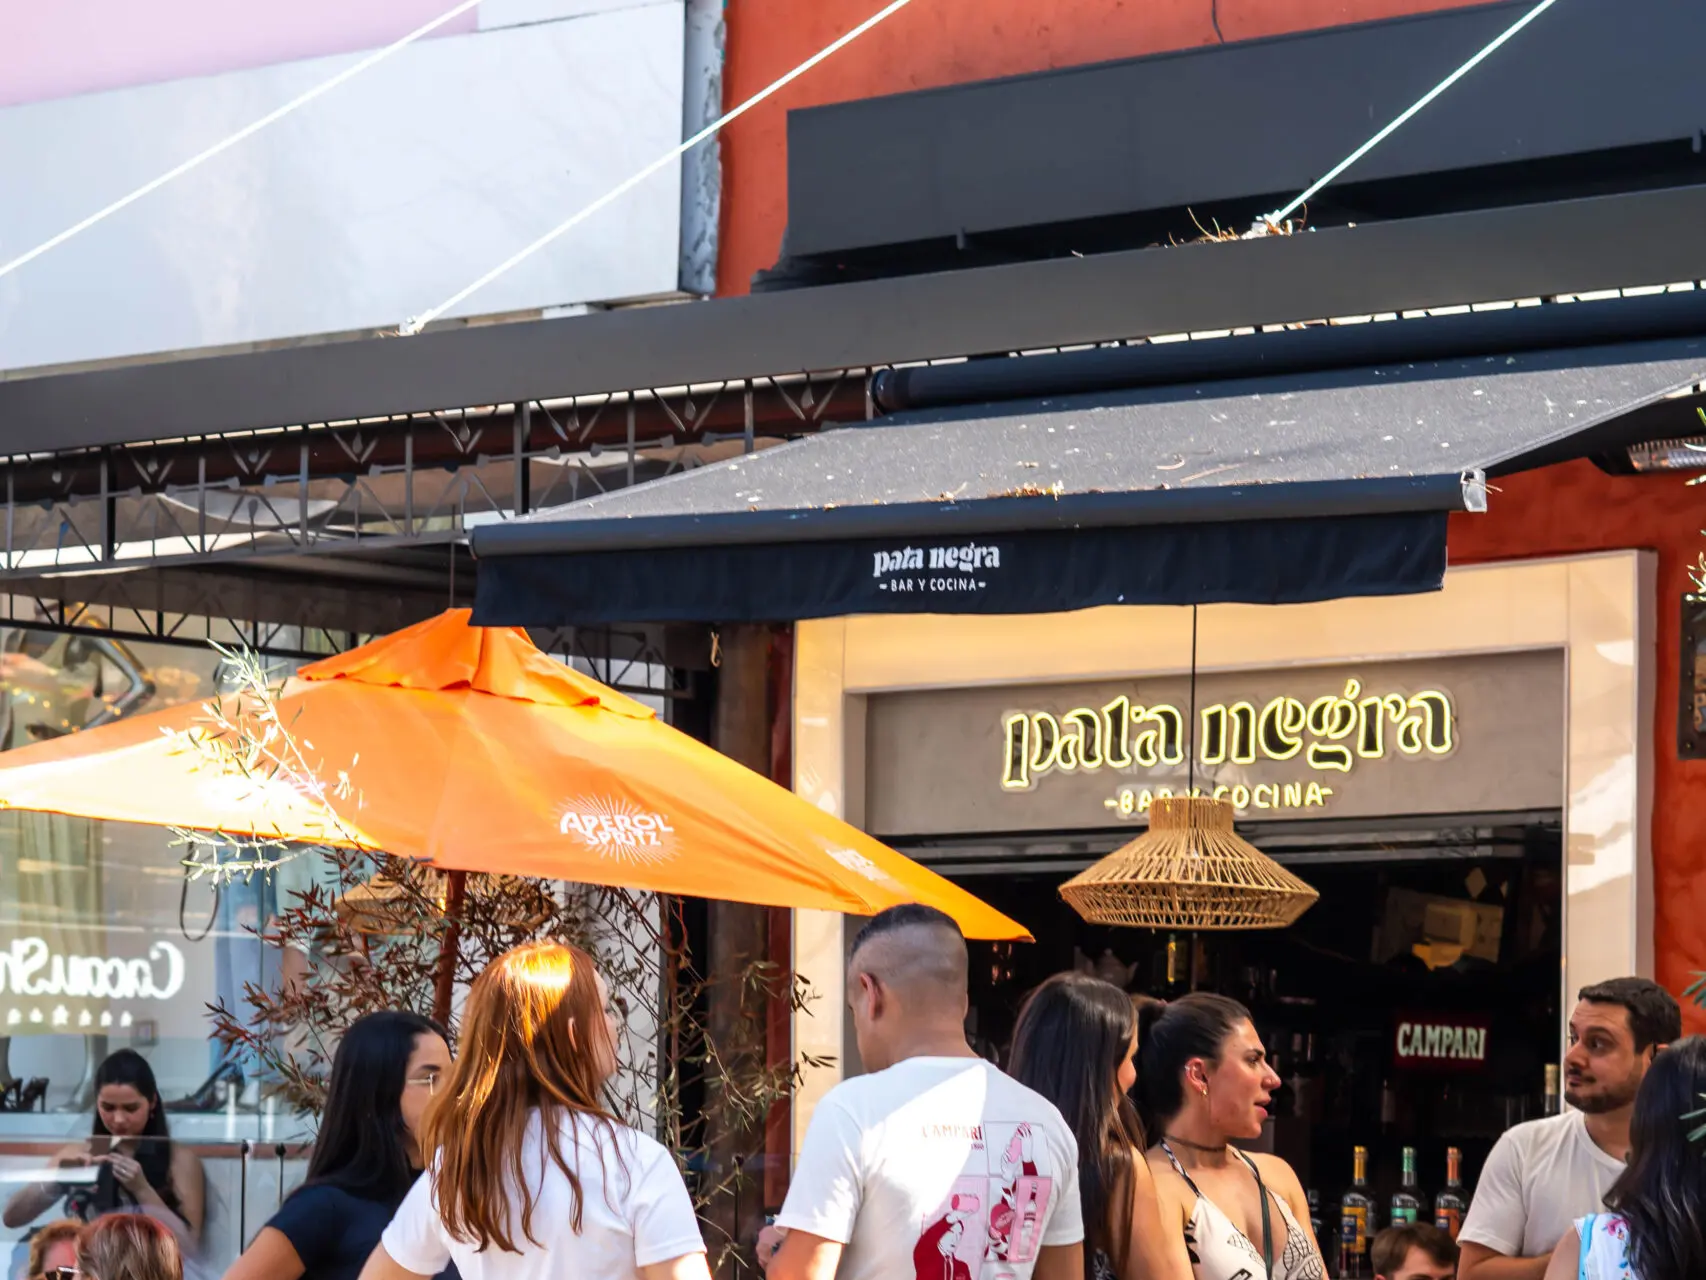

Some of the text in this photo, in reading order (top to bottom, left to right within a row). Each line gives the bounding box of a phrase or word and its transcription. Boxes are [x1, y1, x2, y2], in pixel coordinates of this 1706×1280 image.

[873, 541, 1000, 578] pata negra
[917, 578, 926, 592] Y
[1002, 677, 1453, 788] pata negra
[559, 811, 675, 837] APEROL
[586, 828, 662, 846] SPRITZ
[1397, 1021, 1487, 1060] CAMPARI
